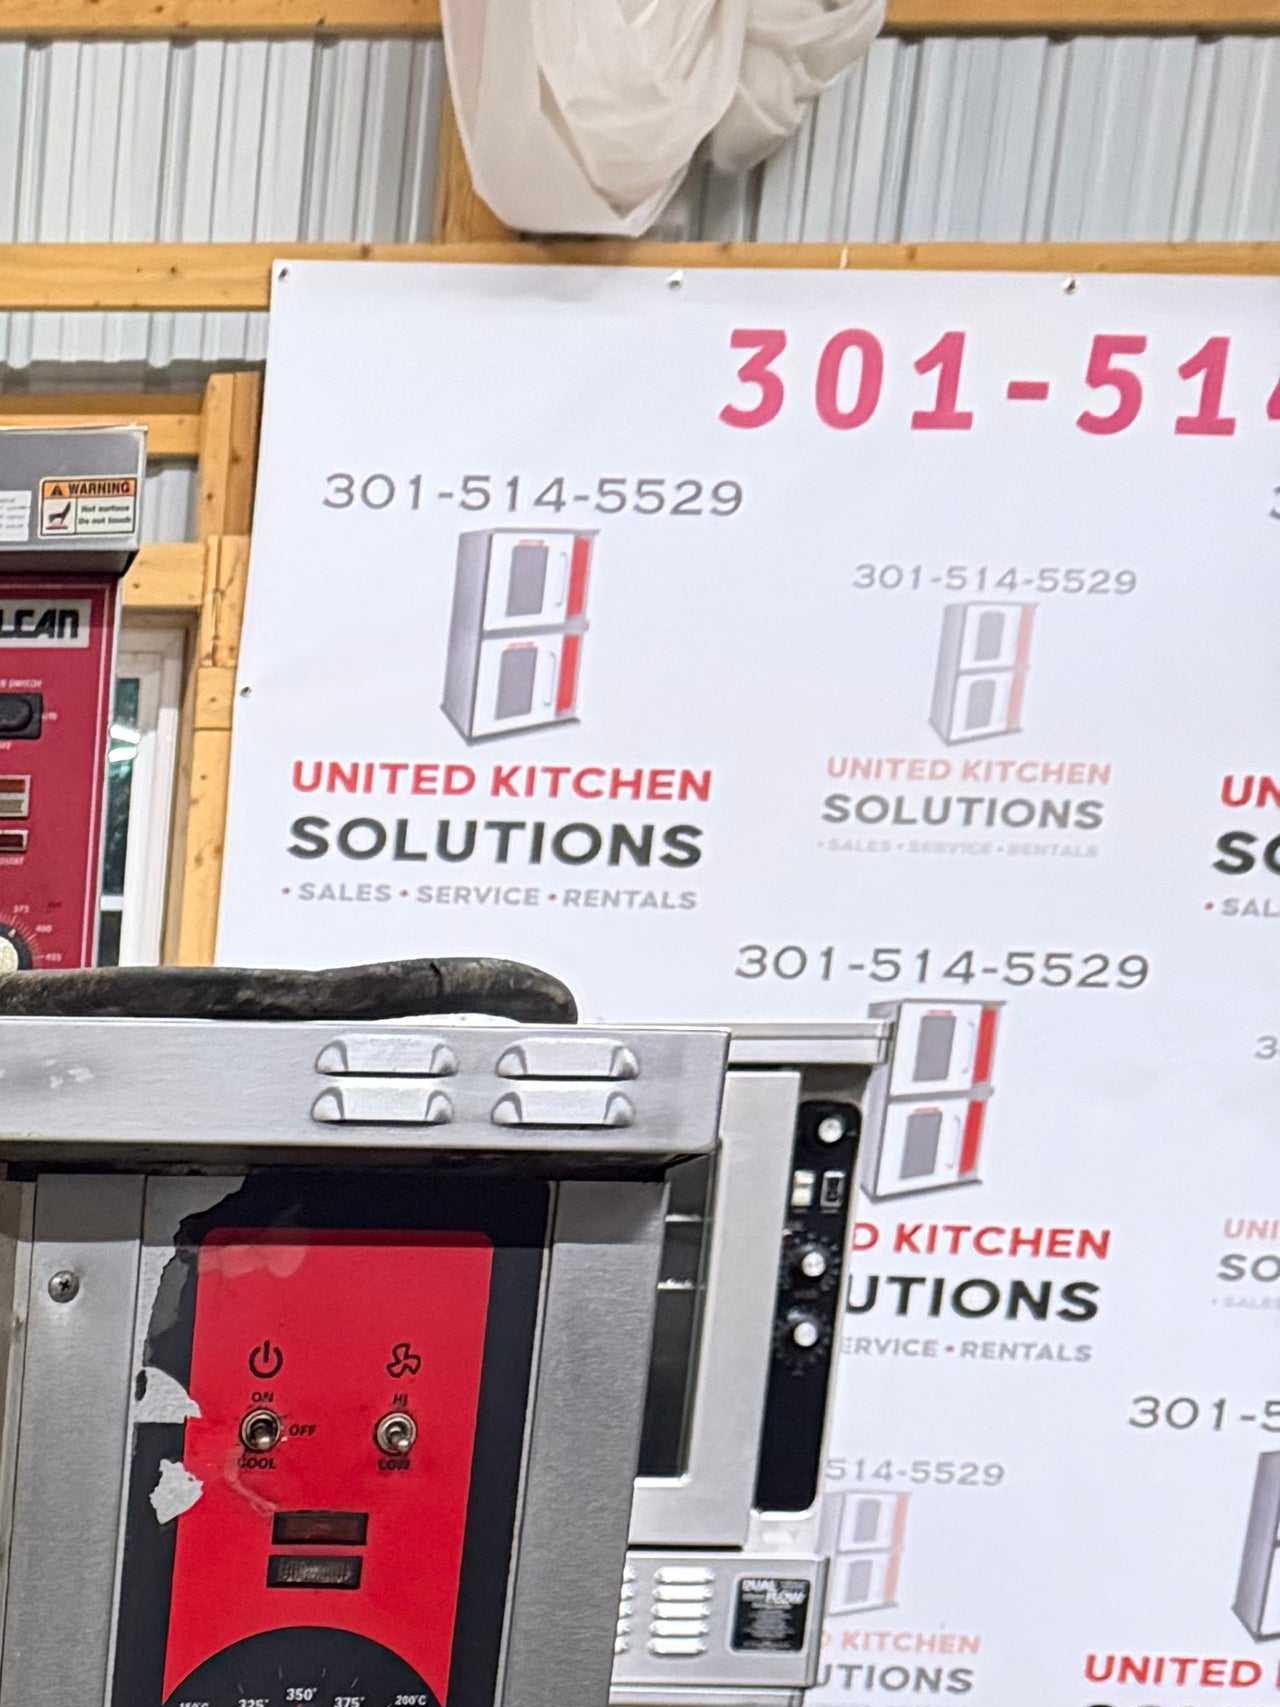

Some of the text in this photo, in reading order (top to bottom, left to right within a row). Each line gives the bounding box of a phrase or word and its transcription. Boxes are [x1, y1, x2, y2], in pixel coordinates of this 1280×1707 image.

[68, 482, 130, 495] WARNING
[322, 472, 743, 517] 301-514-5529
[852, 563, 1138, 595] 301-514-5529
[292, 760, 712, 802] UNITED KITCHEN
[826, 755, 1112, 785] UNITED KITCHEN
[821, 793, 1104, 830] SOLUTIONS
[286, 815, 705, 869] SOLUTIONS
[298, 882, 697, 910] SALES SERVICE RENTALS
[735, 944, 1149, 989] 301-514-5529
[893, 1223, 1111, 1260] KITCHEN
[959, 1340, 1093, 1363] RENTALS
[251, 1392, 274, 1403] ON
[393, 1394, 407, 1406] HI
[289, 1424, 316, 1437] OFF
[237, 1457, 277, 1470] COOL
[378, 1458, 411, 1471] LOW
[841, 1630, 981, 1655] KITCHEN
[1085, 1654, 1262, 1688] UNITED
